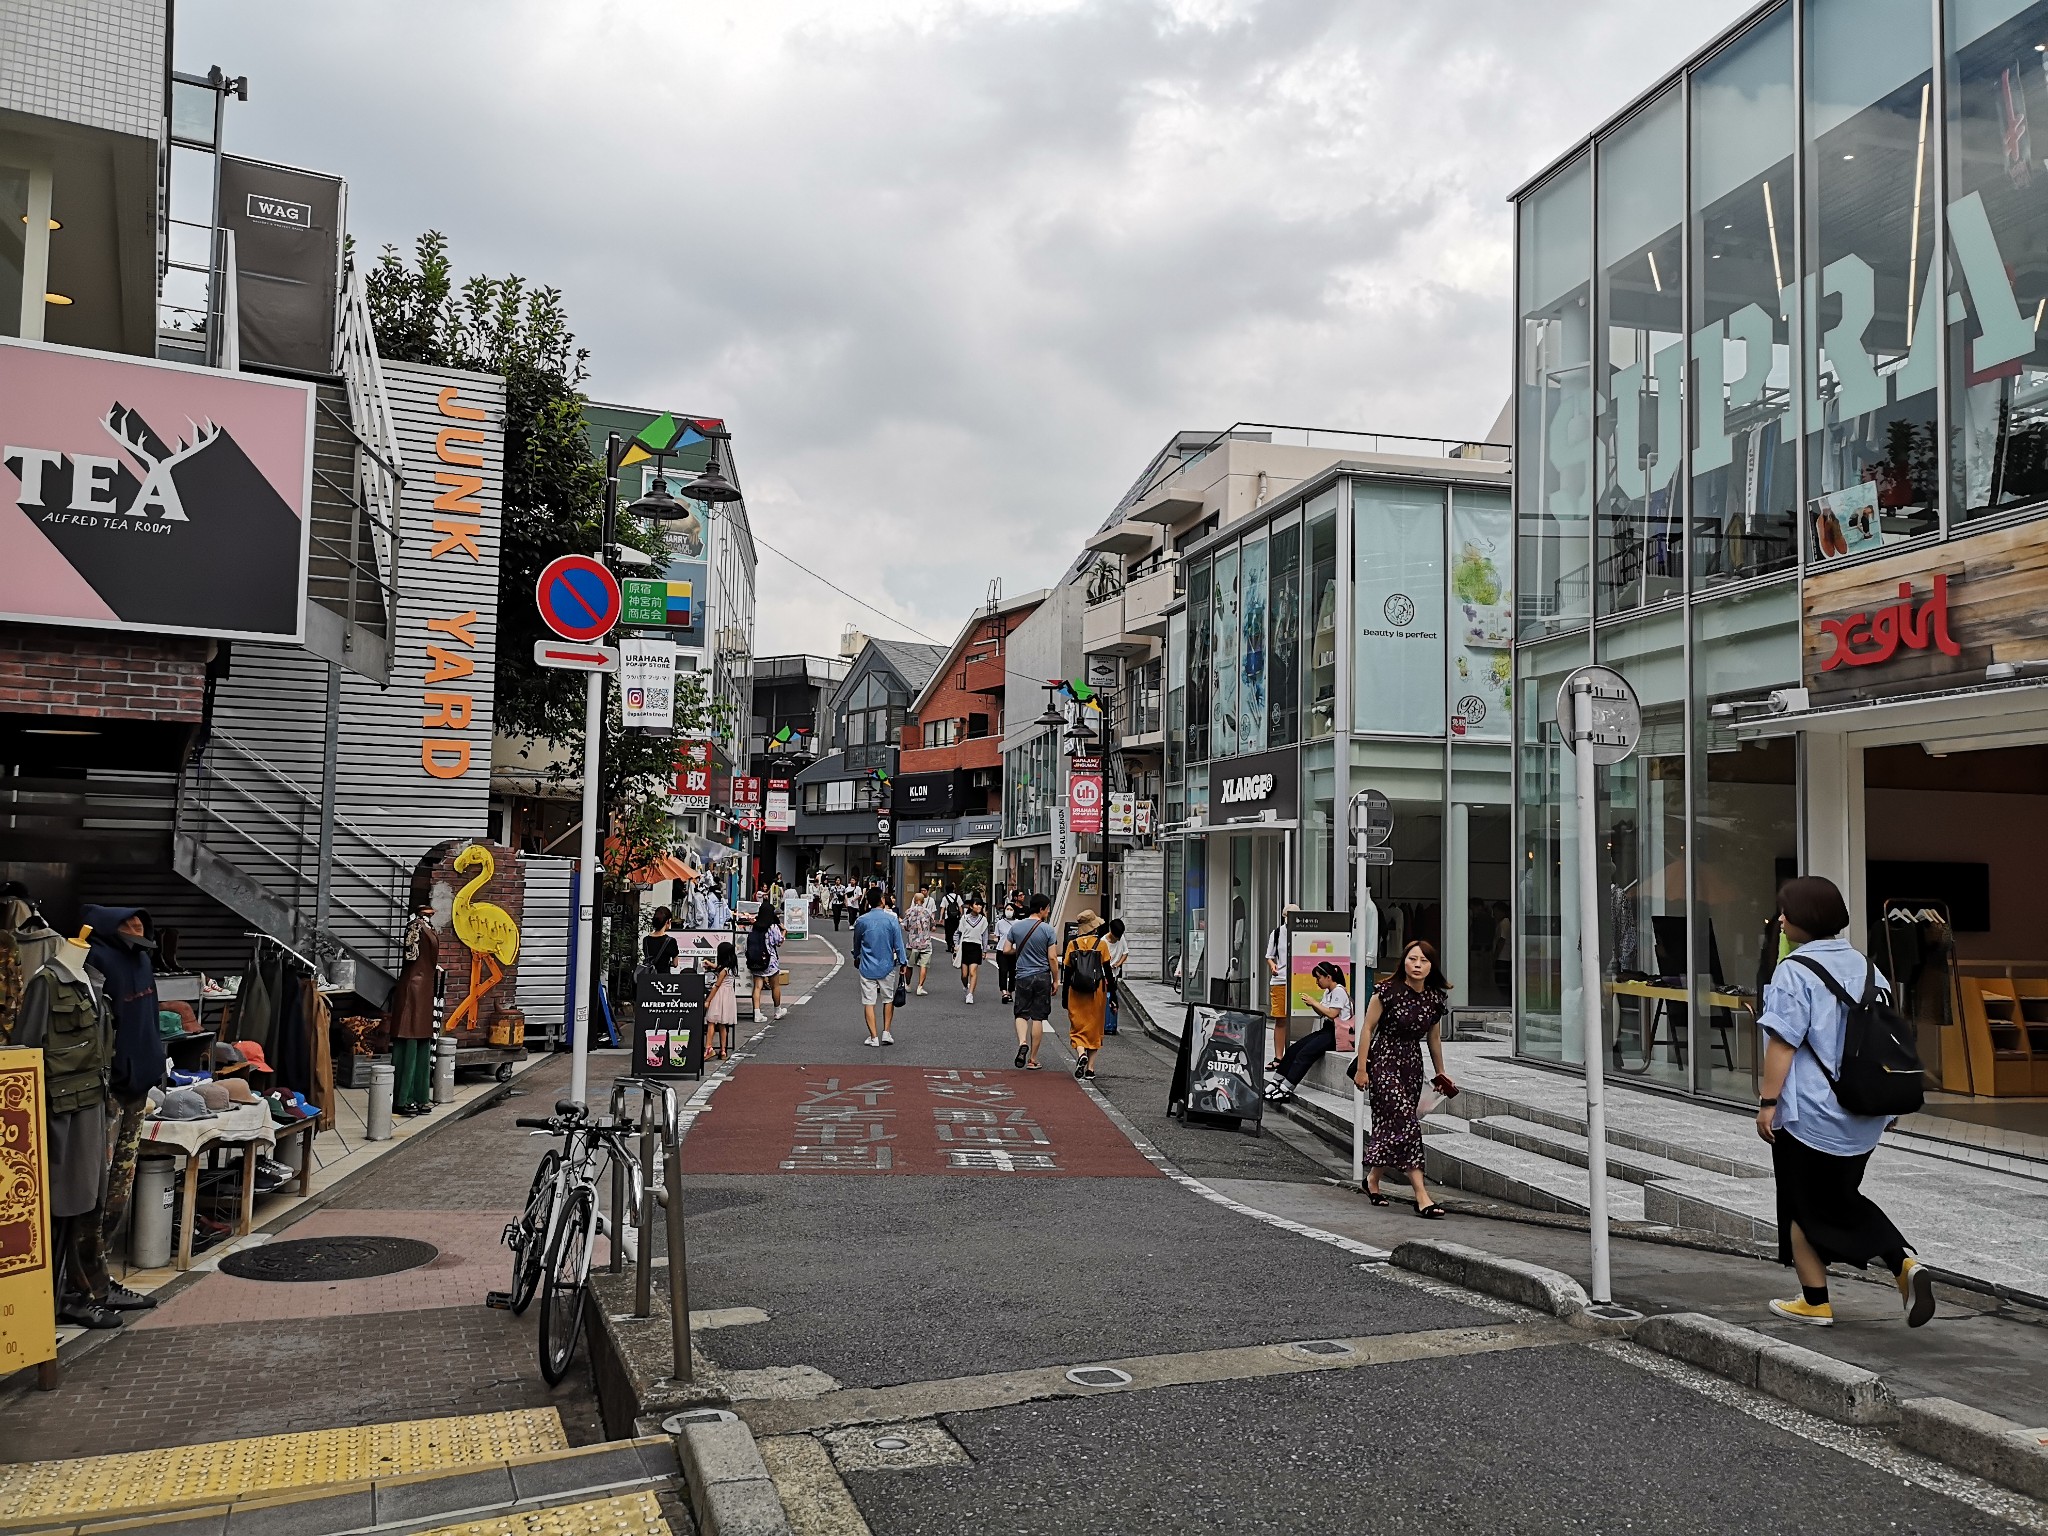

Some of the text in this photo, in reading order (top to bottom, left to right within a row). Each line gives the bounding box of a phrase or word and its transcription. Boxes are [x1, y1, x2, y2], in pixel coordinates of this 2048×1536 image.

[258, 201, 299, 220] WAG
[1549, 190, 2036, 516] SUPRA
[431, 387, 486, 562] JUNK
[4, 445, 190, 521] TEA
[42, 512, 172, 535] ALFRED TEA ROOM
[629, 583, 652, 595] 原宿
[629, 596, 662, 608] 神宮前
[628, 608, 662, 620] 商店会
[1363, 628, 1438, 640] Beauty is perfect
[625, 655, 670, 663] URAHARA
[421, 609, 477, 780] YARD
[735, 779, 758, 789] 古着
[735, 790, 758, 801] 買取
[909, 785, 928, 796] KLON
[666, 983, 679, 993] 2F
[1207, 1060, 1245, 1075] SUPRA
[1219, 1077, 1231, 1086] 2F
